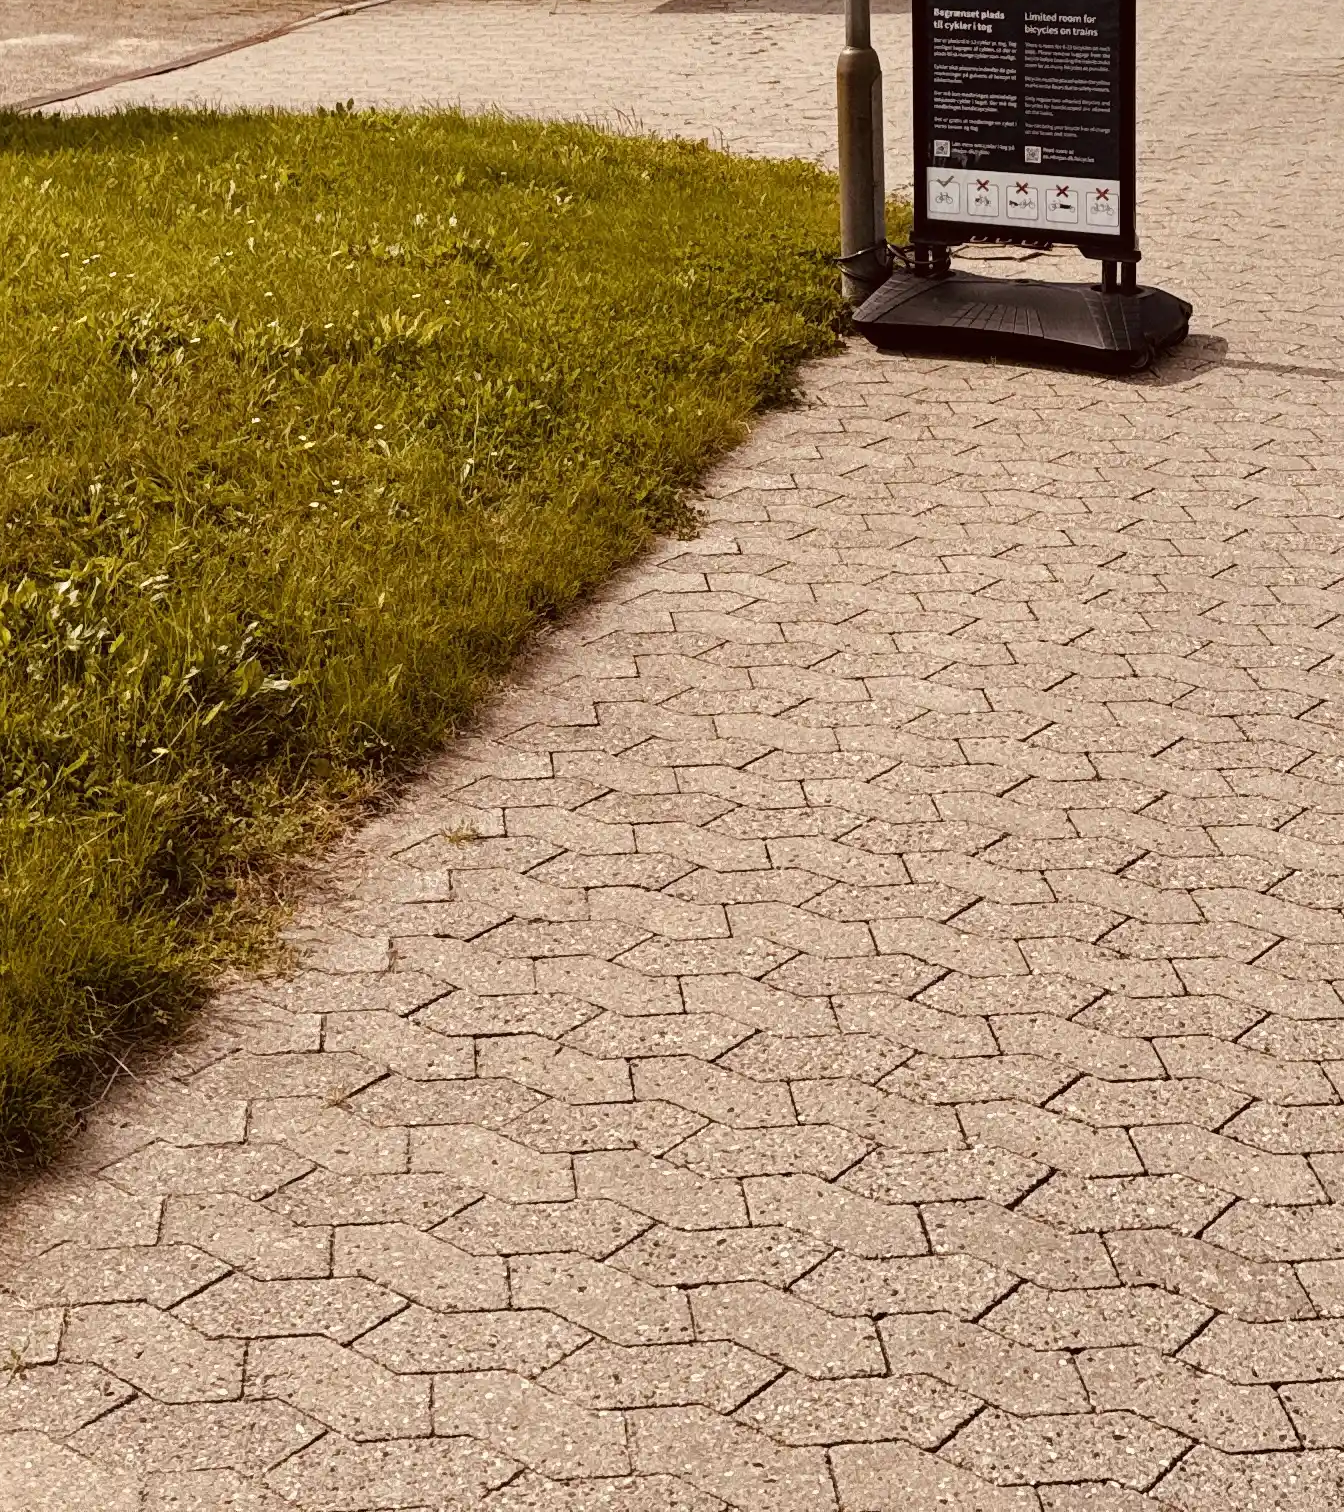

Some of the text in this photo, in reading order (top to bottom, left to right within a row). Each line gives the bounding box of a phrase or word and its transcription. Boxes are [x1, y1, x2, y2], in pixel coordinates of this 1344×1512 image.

[981, 9, 1005, 20] plads
[1024, 11, 1097, 24] Limited room for
[933, 19, 943, 29] til
[944, 20, 972, 31] cykler
[977, 22, 993, 33] tog
[1024, 24, 1099, 37] bicycles on trains
